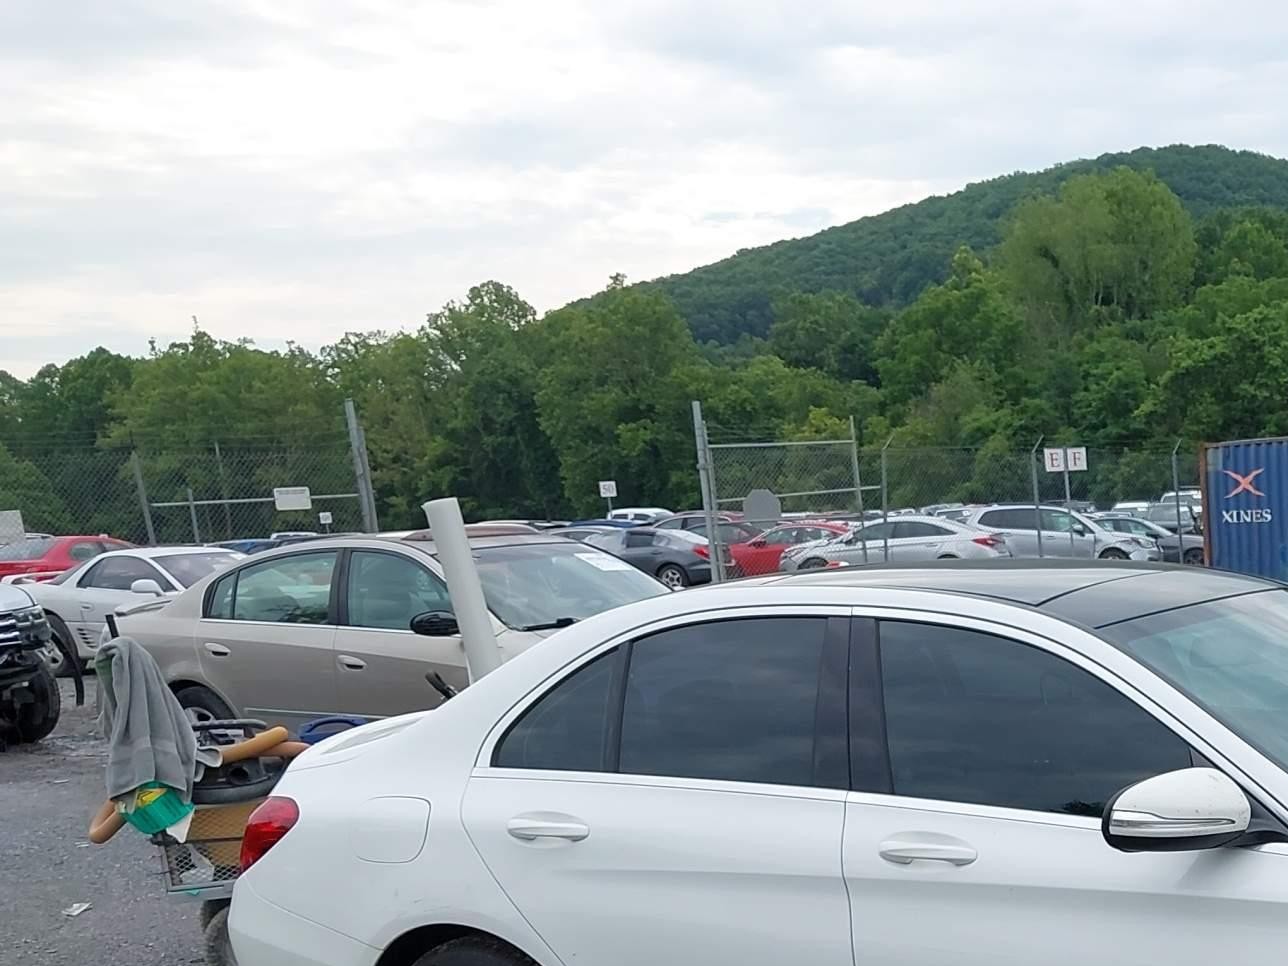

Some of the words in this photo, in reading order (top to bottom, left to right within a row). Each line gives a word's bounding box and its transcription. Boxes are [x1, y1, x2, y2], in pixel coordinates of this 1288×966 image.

[1049, 452, 1060, 468] E
[1072, 451, 1081, 467] F
[1222, 508, 1272, 524] XINES
